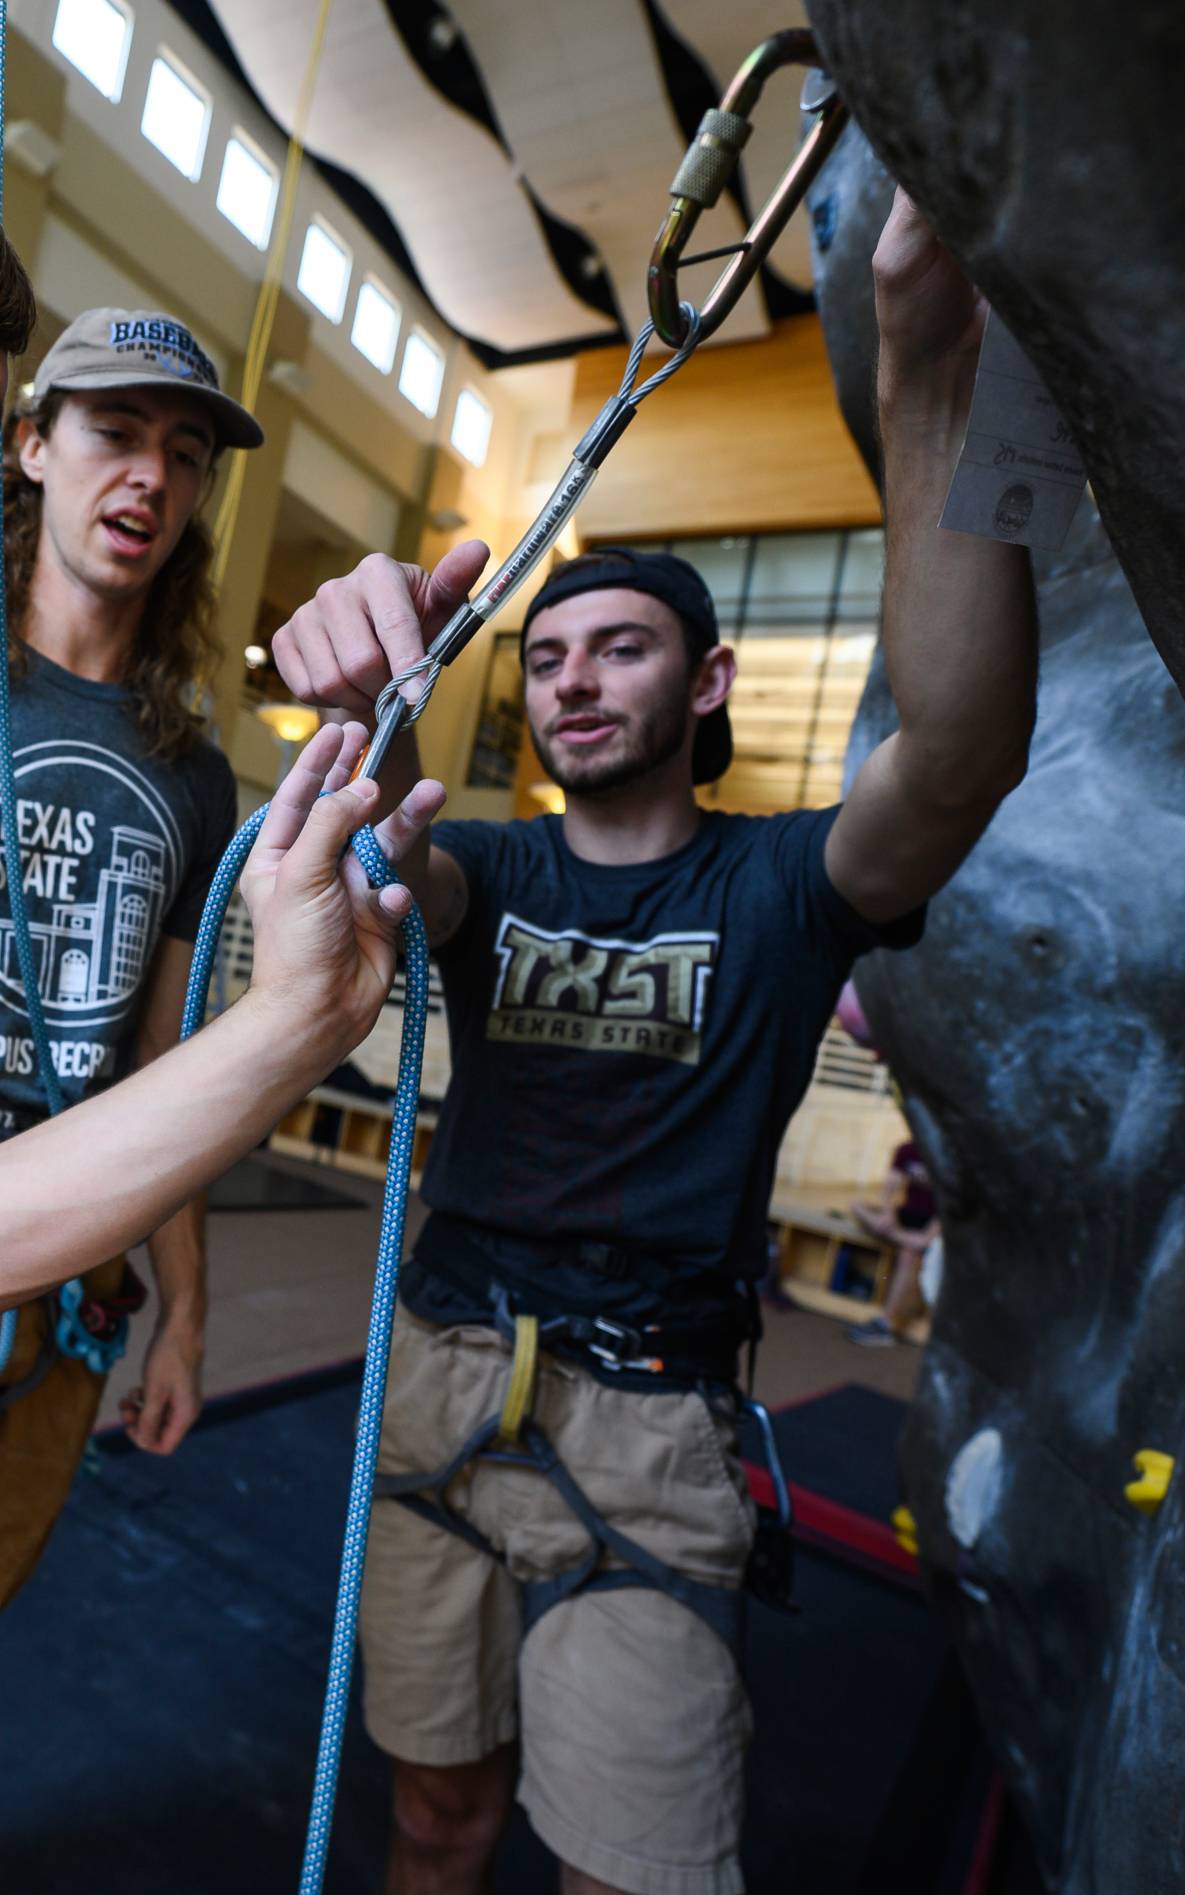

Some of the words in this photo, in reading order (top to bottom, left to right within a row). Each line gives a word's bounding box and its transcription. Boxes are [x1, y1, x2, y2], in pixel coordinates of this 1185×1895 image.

[500, 926, 712, 1024] TXST
[501, 1014, 584, 1039] TEXAS
[601, 1025, 685, 1054] STATE
